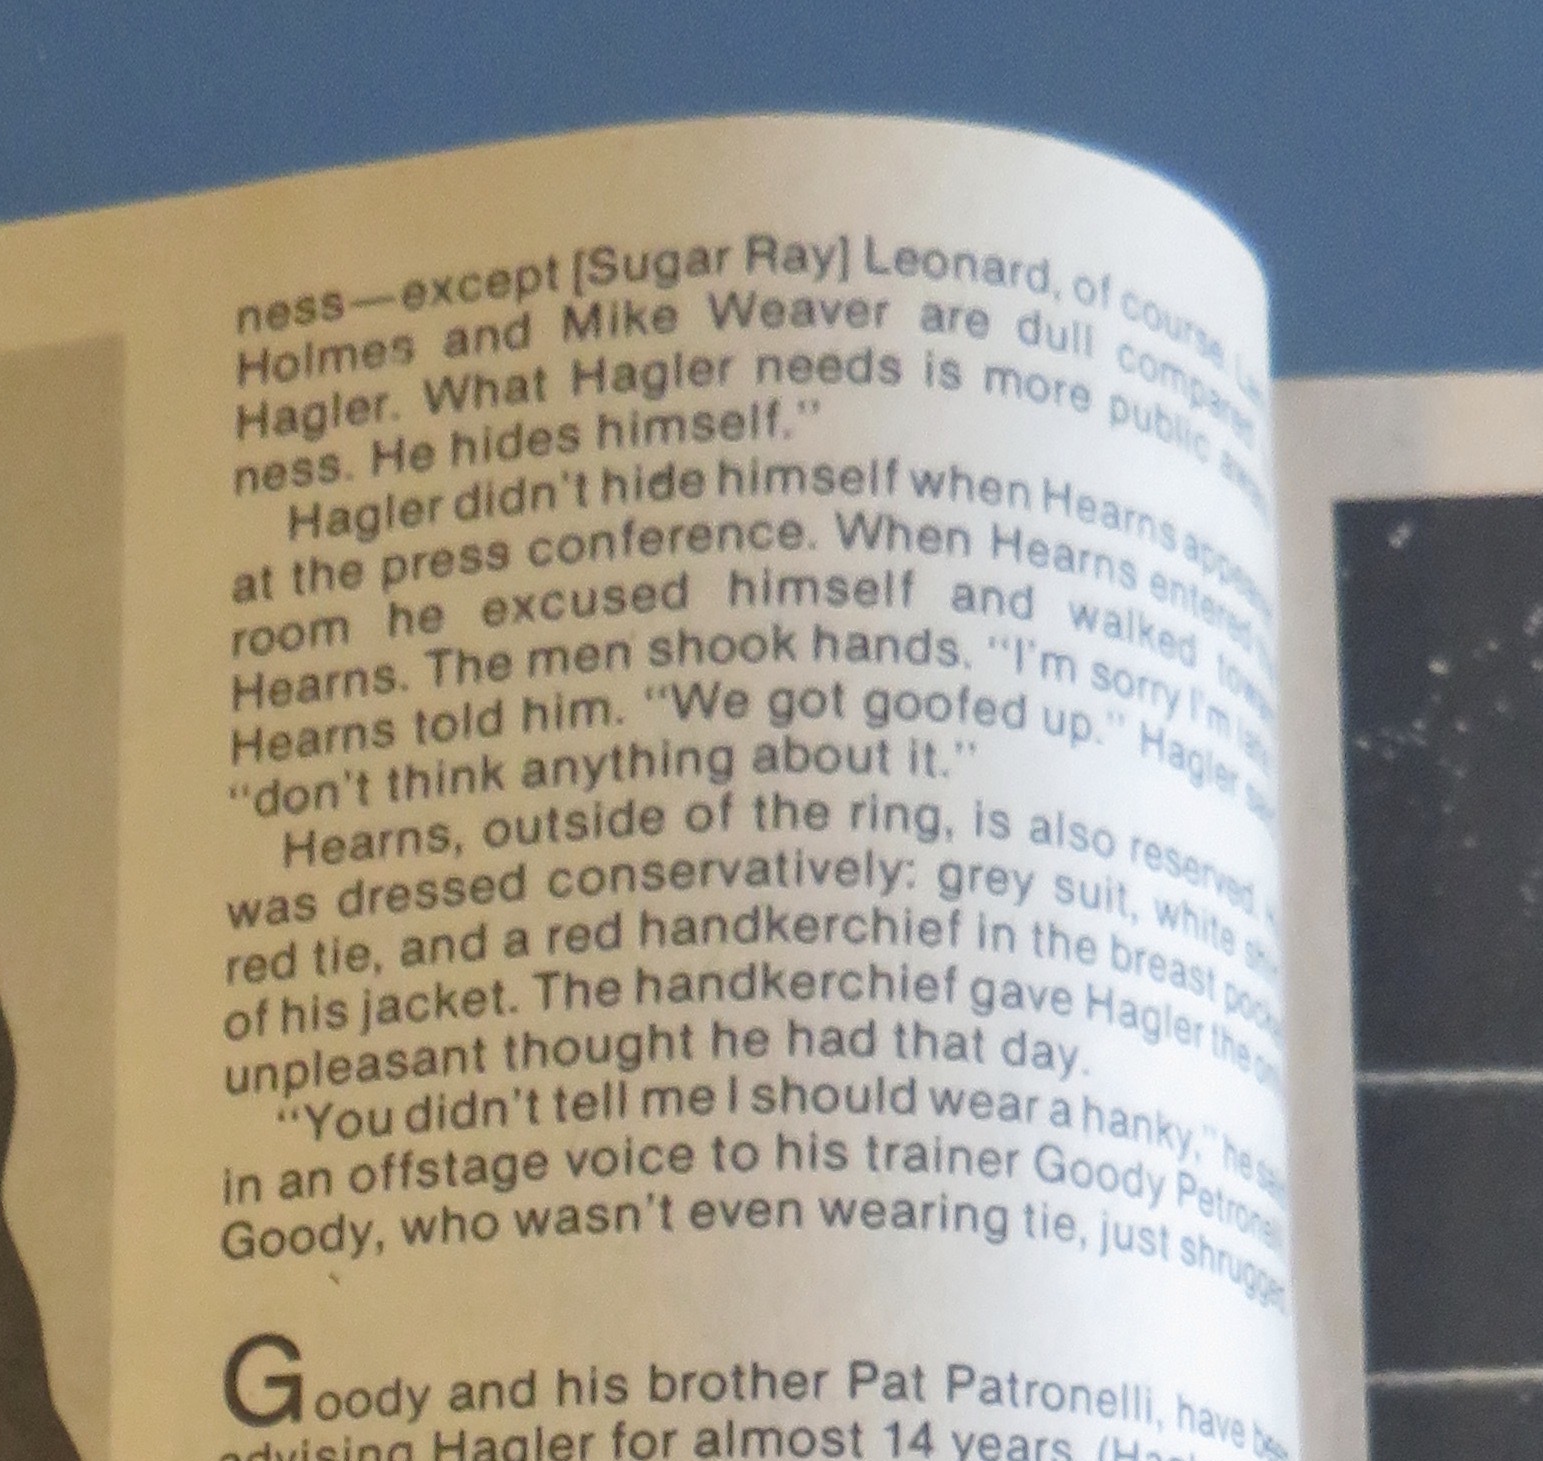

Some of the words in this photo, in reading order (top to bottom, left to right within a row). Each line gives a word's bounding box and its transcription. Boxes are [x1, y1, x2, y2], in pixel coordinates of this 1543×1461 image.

[865, 234, 1063, 301] Leonard,
[1073, 273, 1112, 309] of
[233, 452, 353, 497] ness.
[372, 437, 436, 476] He
[449, 421, 581, 467] hides
[597, 398, 821, 451] himself."
[288, 493, 444, 544] Hagler
[453, 470, 588, 522] didn't
[601, 462, 706, 505] hide
[717, 456, 899, 498] himself
[910, 462, 1031, 509] when
[1043, 477, 1178, 552] Hearns
[227, 769, 370, 818] "don't
[387, 756, 505, 802] think
[521, 739, 735, 791] anything
[752, 734, 890, 775] about
[909, 738, 977, 781] it."
[224, 1036, 486, 1100] unpleasant
[504, 1023, 694, 1074] thought
[711, 1020, 770, 1058] he
[788, 1018, 877, 1058] had
[894, 1020, 984, 1064] that
[1001, 1030, 1093, 1081] day.
[223, 1332, 431, 1428] Goody
[448, 1368, 537, 1413] and
[557, 1365, 629, 1407] his
[649, 1361, 829, 1403] brother
[848, 1359, 925, 1402] Pat
[946, 1362, 1163, 1431] Patronelli,
[1177, 1394, 1246, 1449] have
